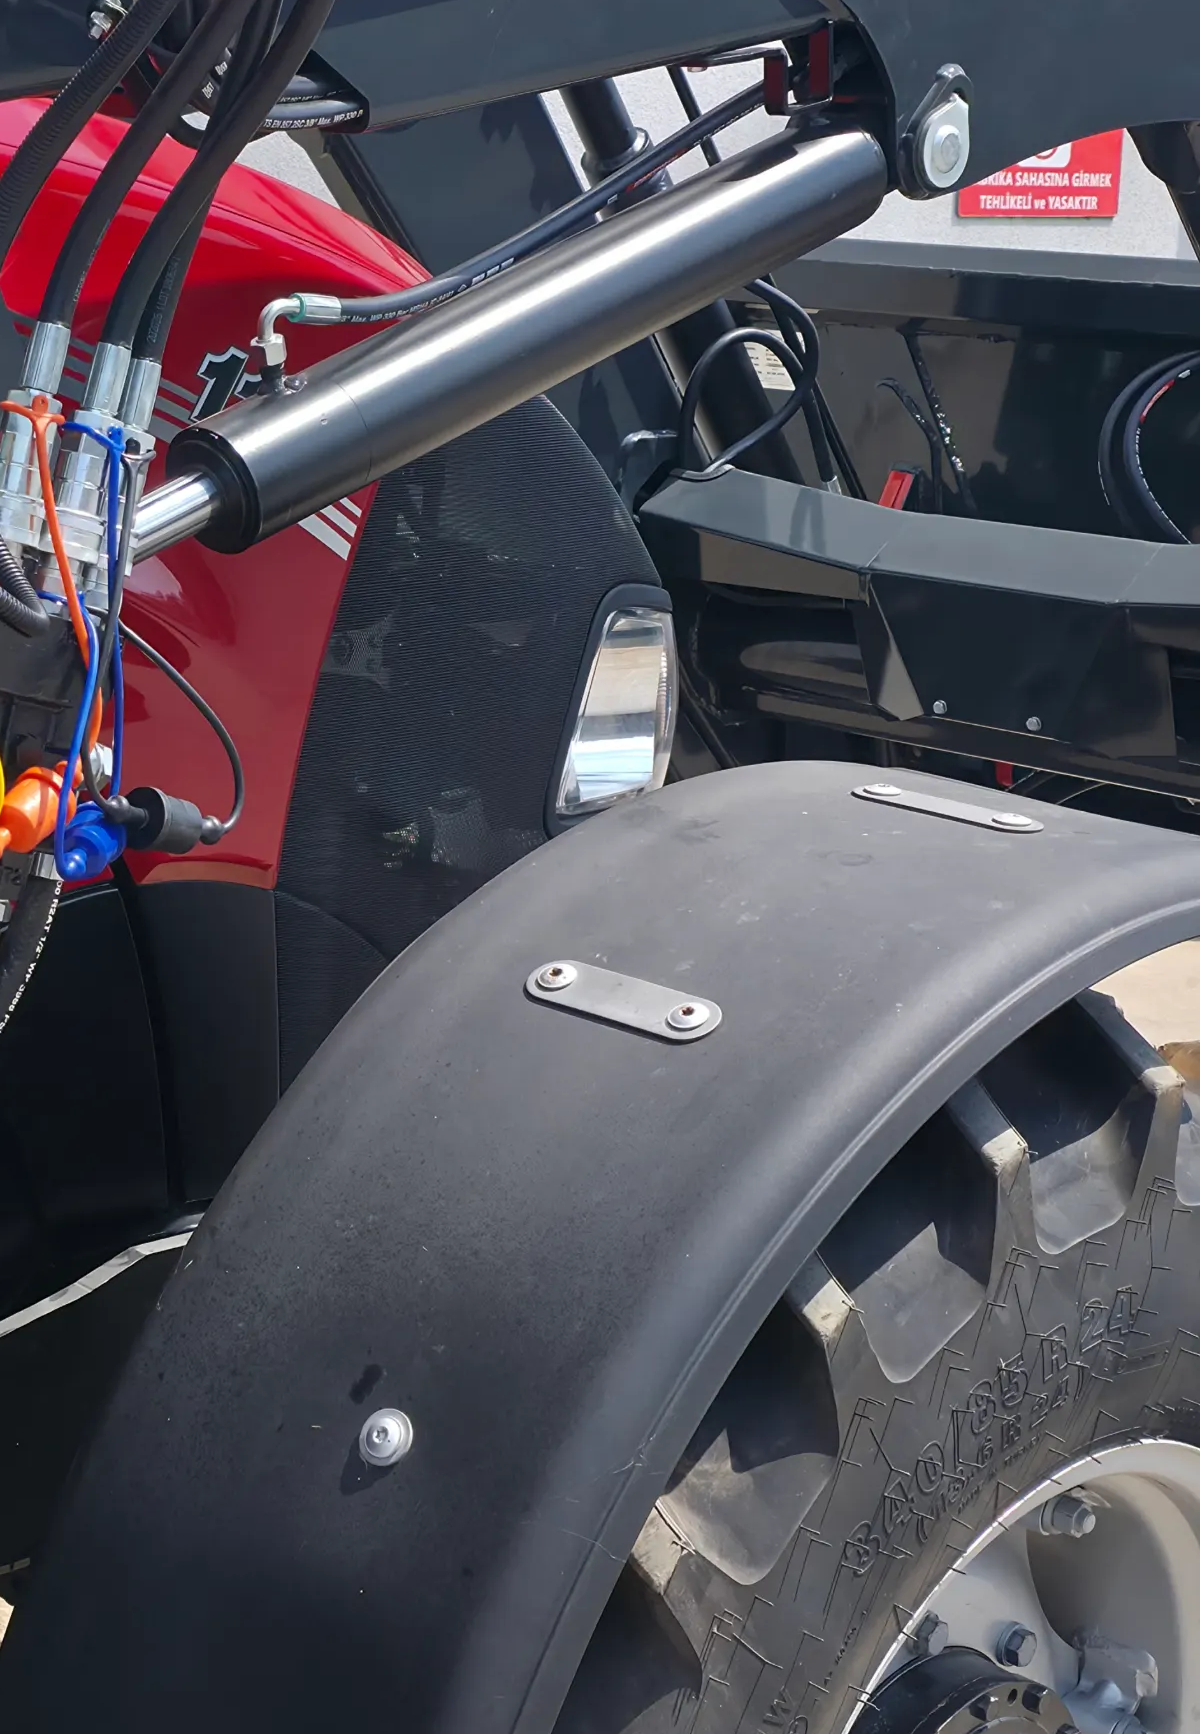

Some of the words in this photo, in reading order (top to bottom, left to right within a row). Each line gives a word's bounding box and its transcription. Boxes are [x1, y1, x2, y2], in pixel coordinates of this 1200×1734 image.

[1015, 172, 1069, 187] SAHASINA
[1072, 170, 1112, 187] GİRMEK
[980, 192, 1031, 209] TEHLİKELİ
[1034, 198, 1046, 209] ve
[1049, 196, 1098, 209] YASAKTIR
[43, 899, 59, 933] R2AT
